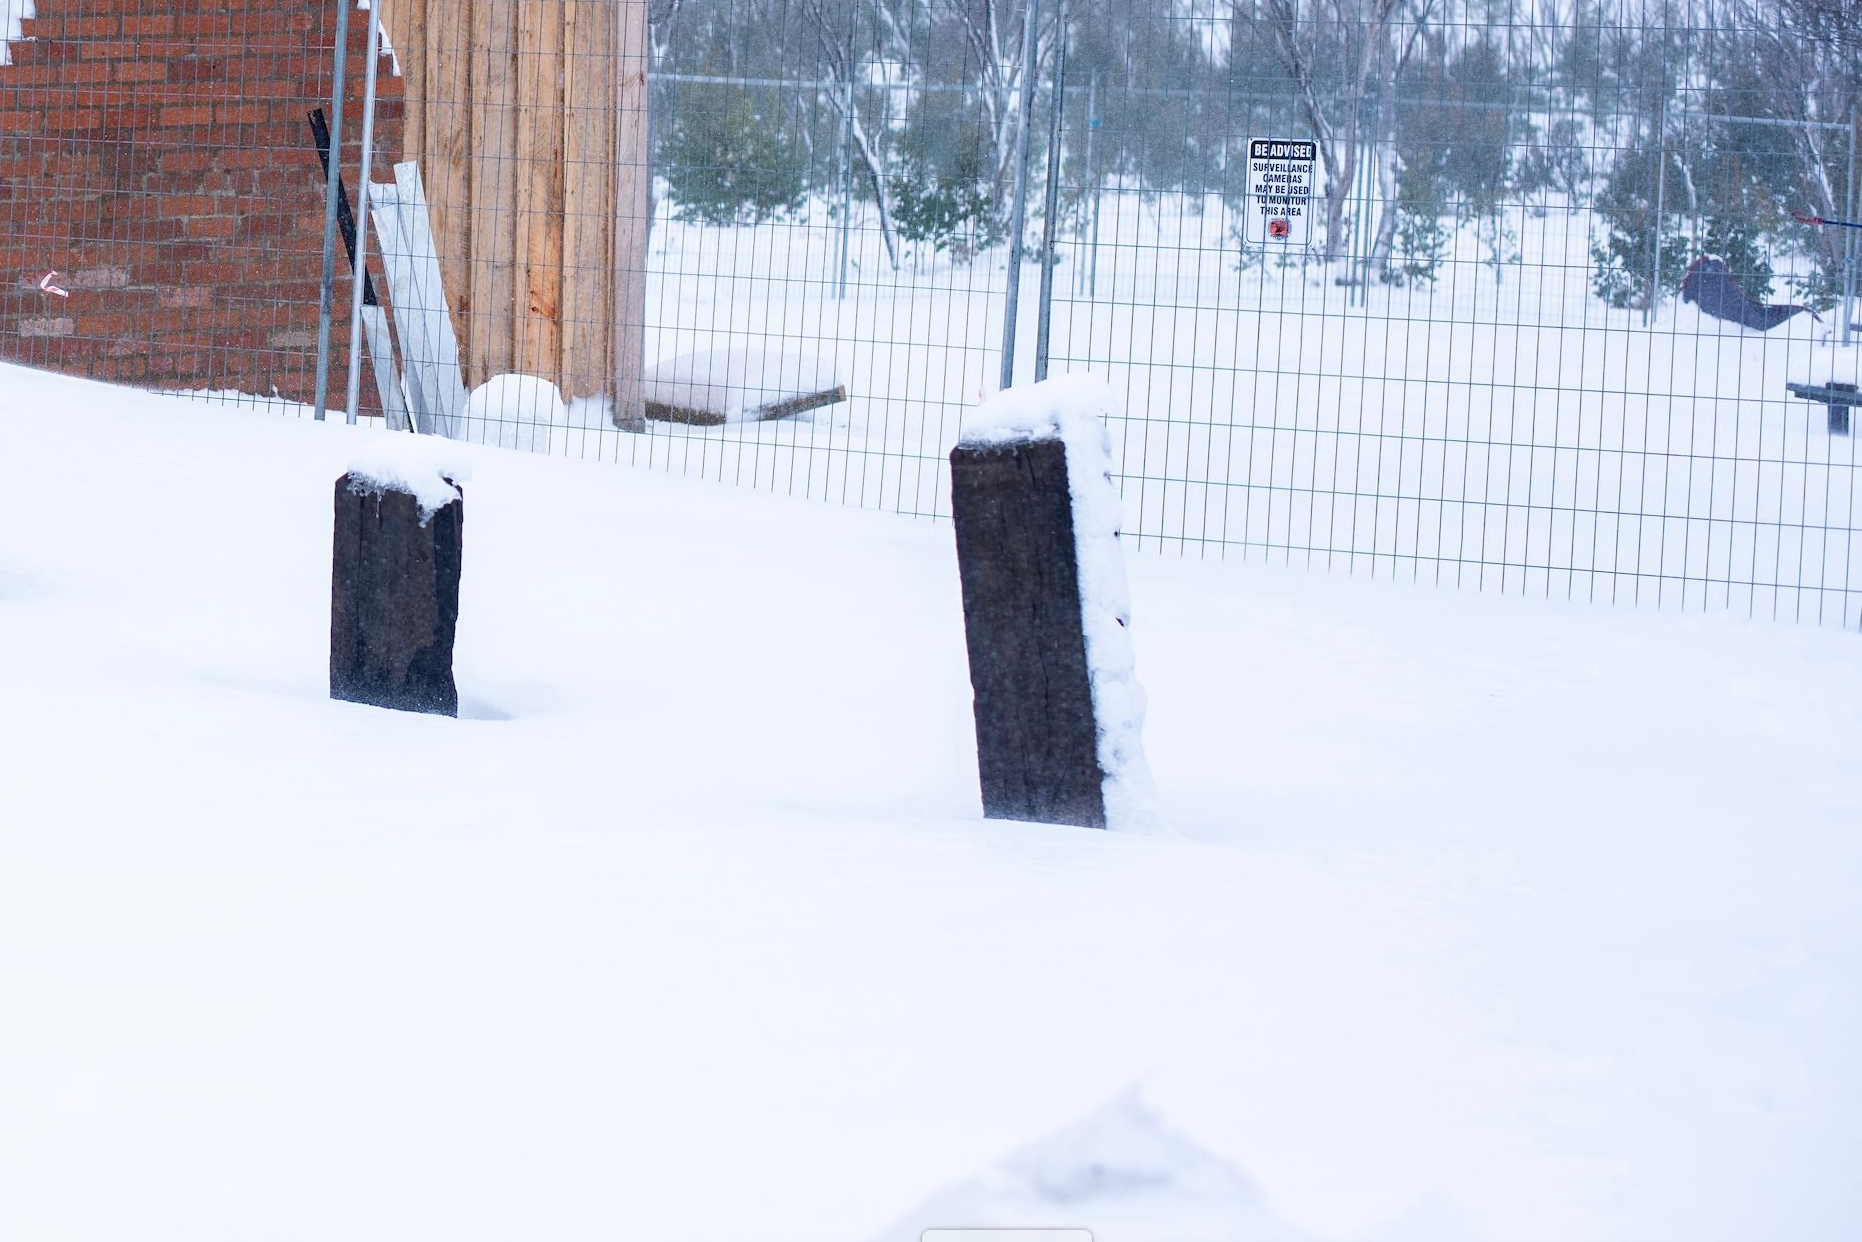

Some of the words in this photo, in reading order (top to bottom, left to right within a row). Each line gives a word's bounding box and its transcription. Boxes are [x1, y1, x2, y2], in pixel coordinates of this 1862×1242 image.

[1254, 144, 1268, 156] BE
[1270, 144, 1312, 158] ADVISED
[1262, 173, 1302, 184] CAMERAS
[1255, 184, 1273, 194] MAY
[1275, 185, 1286, 194] BE
[1287, 186, 1309, 195] USED
[1257, 195, 1267, 204] TO
[1268, 196, 1307, 206] MONITOR
[1260, 206, 1279, 215] THIS
[1280, 207, 1302, 217] AREA
